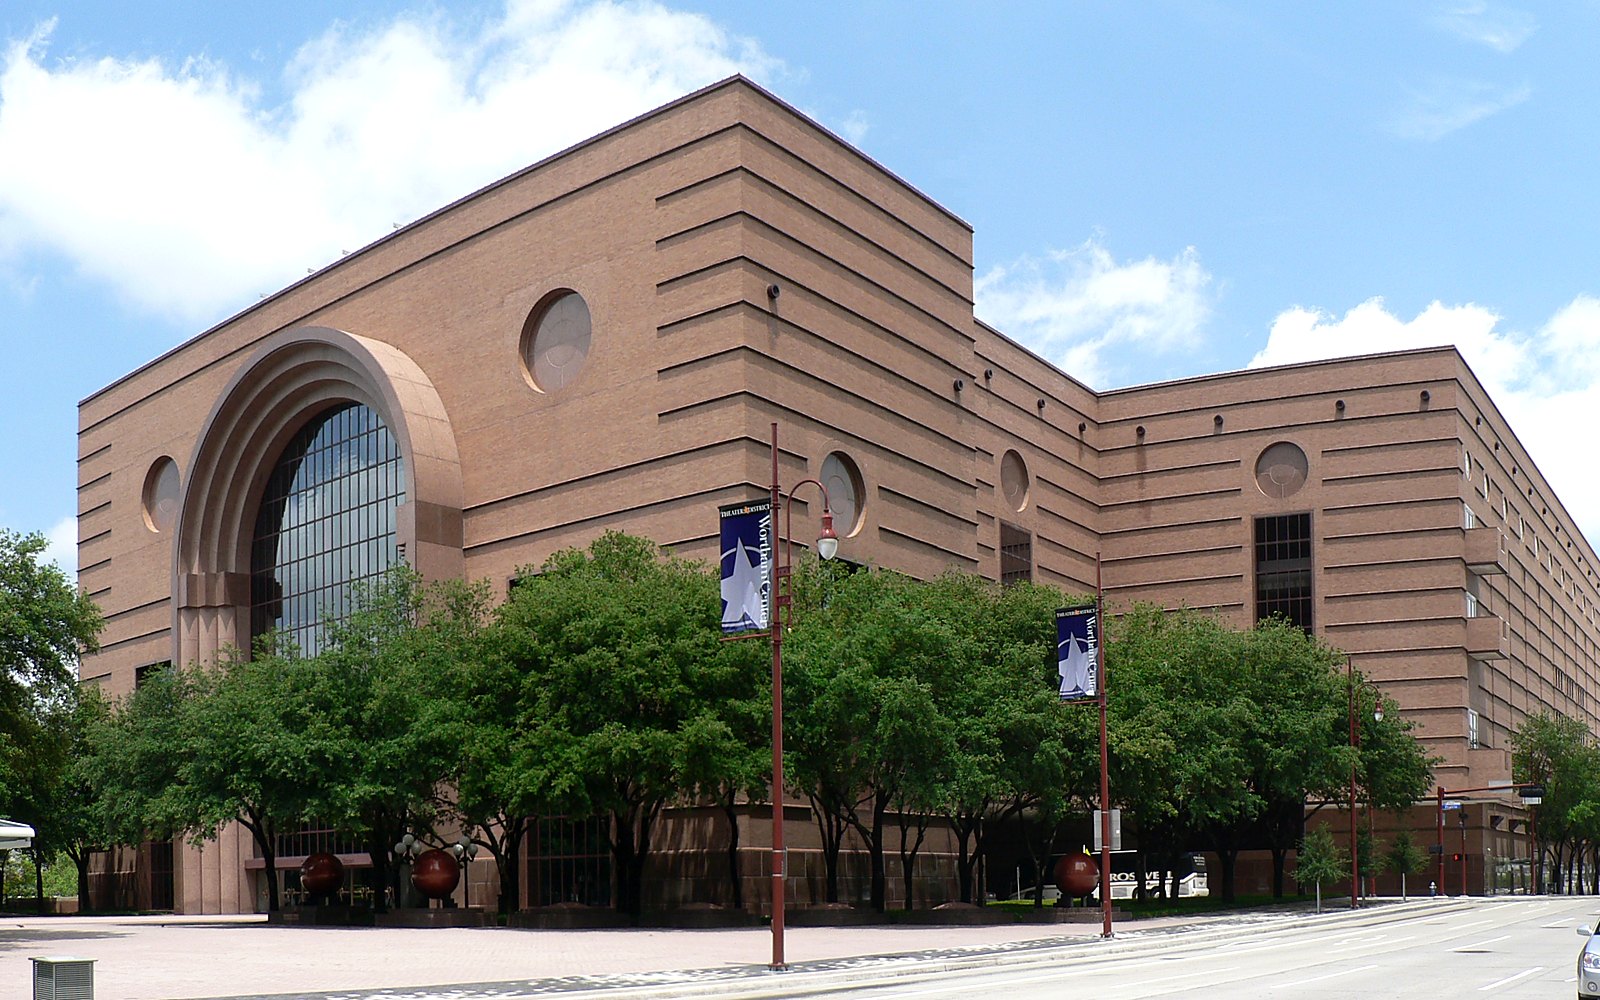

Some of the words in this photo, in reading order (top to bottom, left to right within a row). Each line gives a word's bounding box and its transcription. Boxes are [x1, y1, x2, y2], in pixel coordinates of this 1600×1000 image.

[758, 514, 771, 579] Wortham
[759, 580, 771, 629] Center
[1086, 616, 1097, 662] Wortham
